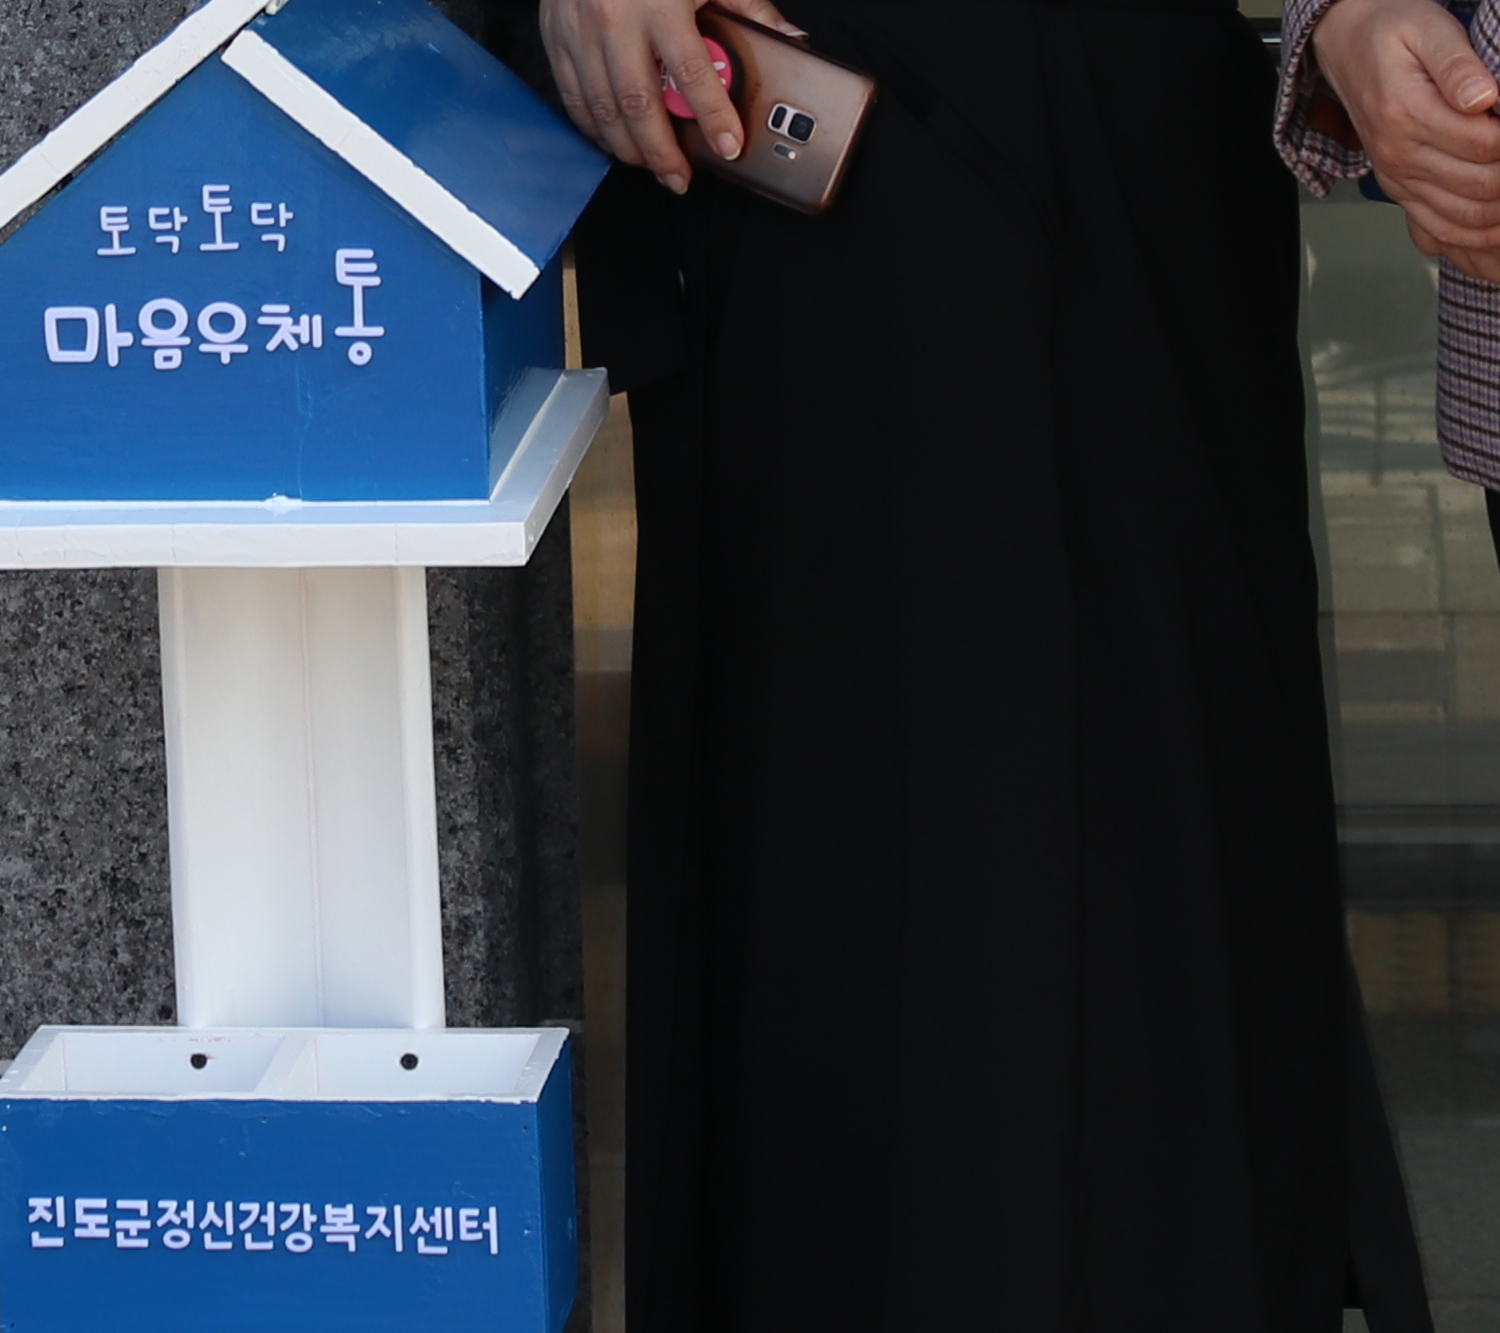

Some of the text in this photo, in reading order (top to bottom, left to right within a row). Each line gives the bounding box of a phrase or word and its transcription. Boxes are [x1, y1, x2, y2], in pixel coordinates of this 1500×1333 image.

[96, 184, 294, 256] 토닥토닥
[44, 248, 385, 370] 마음우체통
[27, 1195, 499, 1256] 진도군정신건강복지센터
